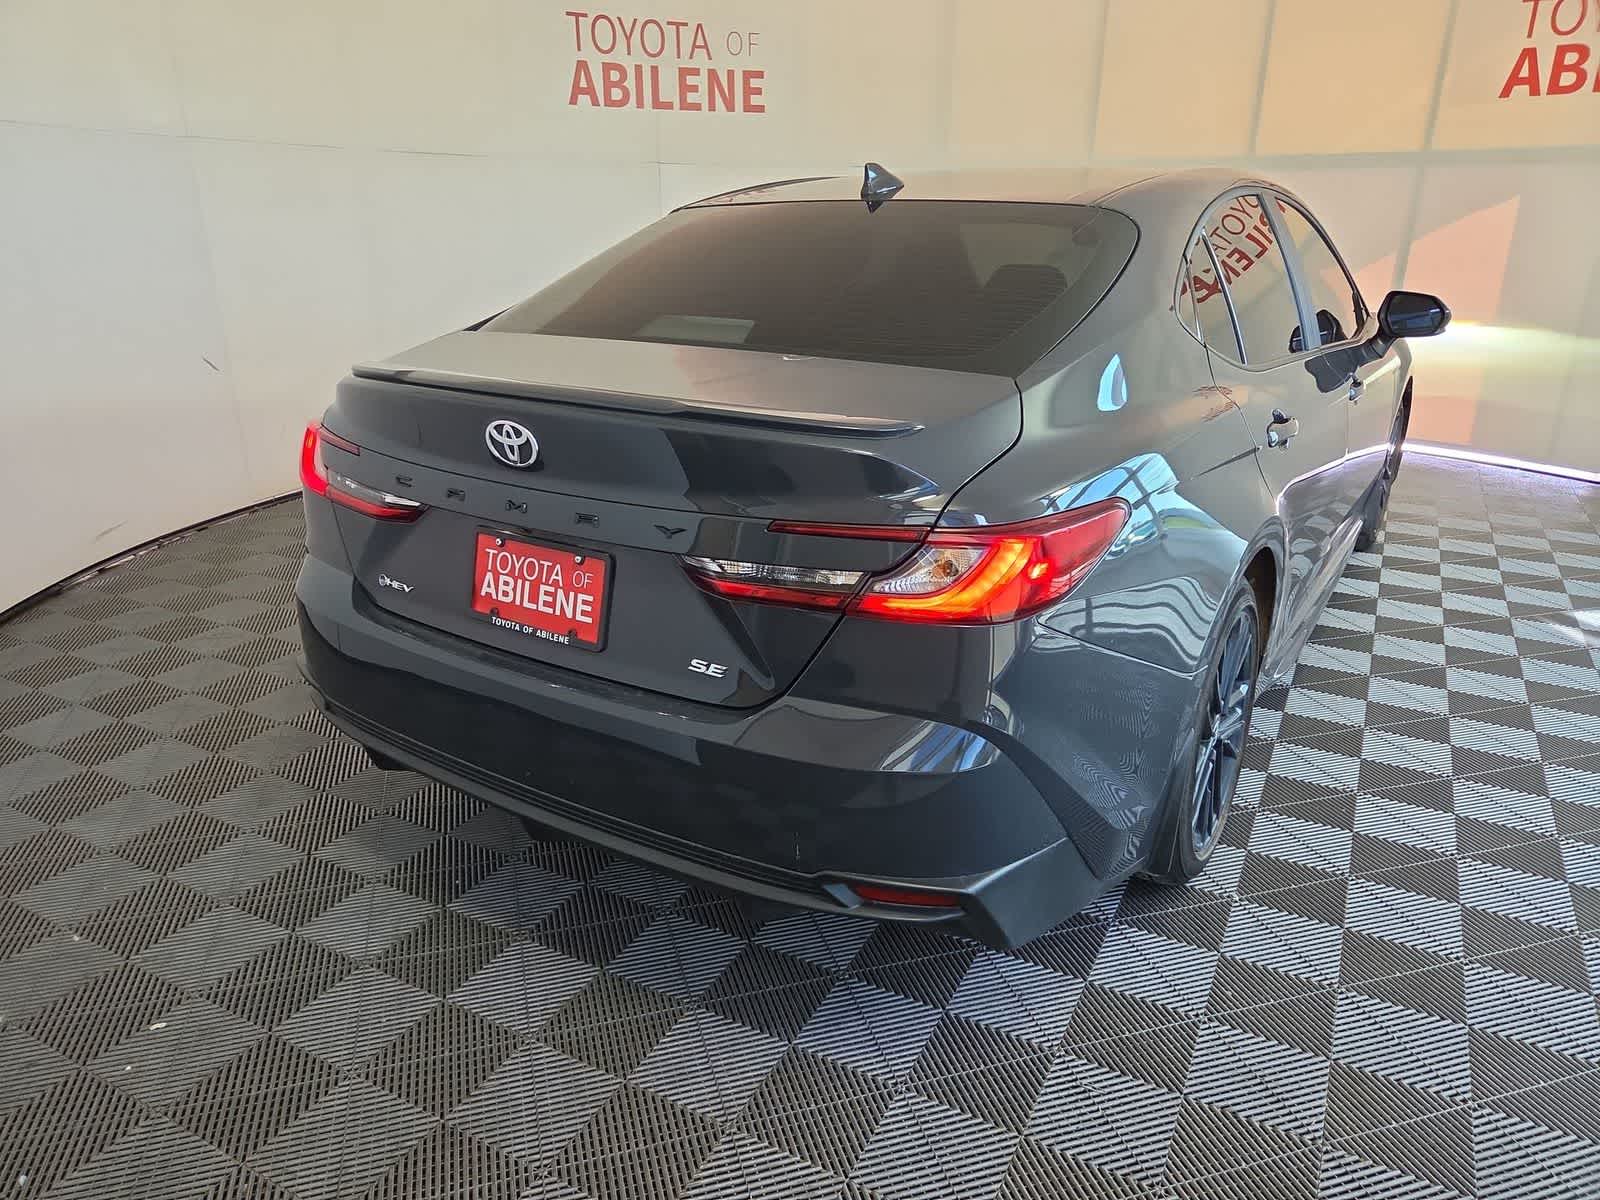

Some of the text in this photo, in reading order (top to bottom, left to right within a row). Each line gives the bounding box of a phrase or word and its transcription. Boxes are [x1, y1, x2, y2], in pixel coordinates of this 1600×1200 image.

[565, 11, 761, 60] TOYOTA OF
[1522, 0, 1600, 39] TO
[568, 59, 766, 113] ABILENE
[1498, 43, 1600, 99] AB
[396, 475, 688, 539] CAMRY
[386, 578, 414, 592] HEV
[485, 548, 595, 589] TOYOTA OF
[480, 571, 594, 624] ABILENE
[491, 616, 570, 645] TOYOTA OF ABILENE
[688, 658, 728, 678] SE
